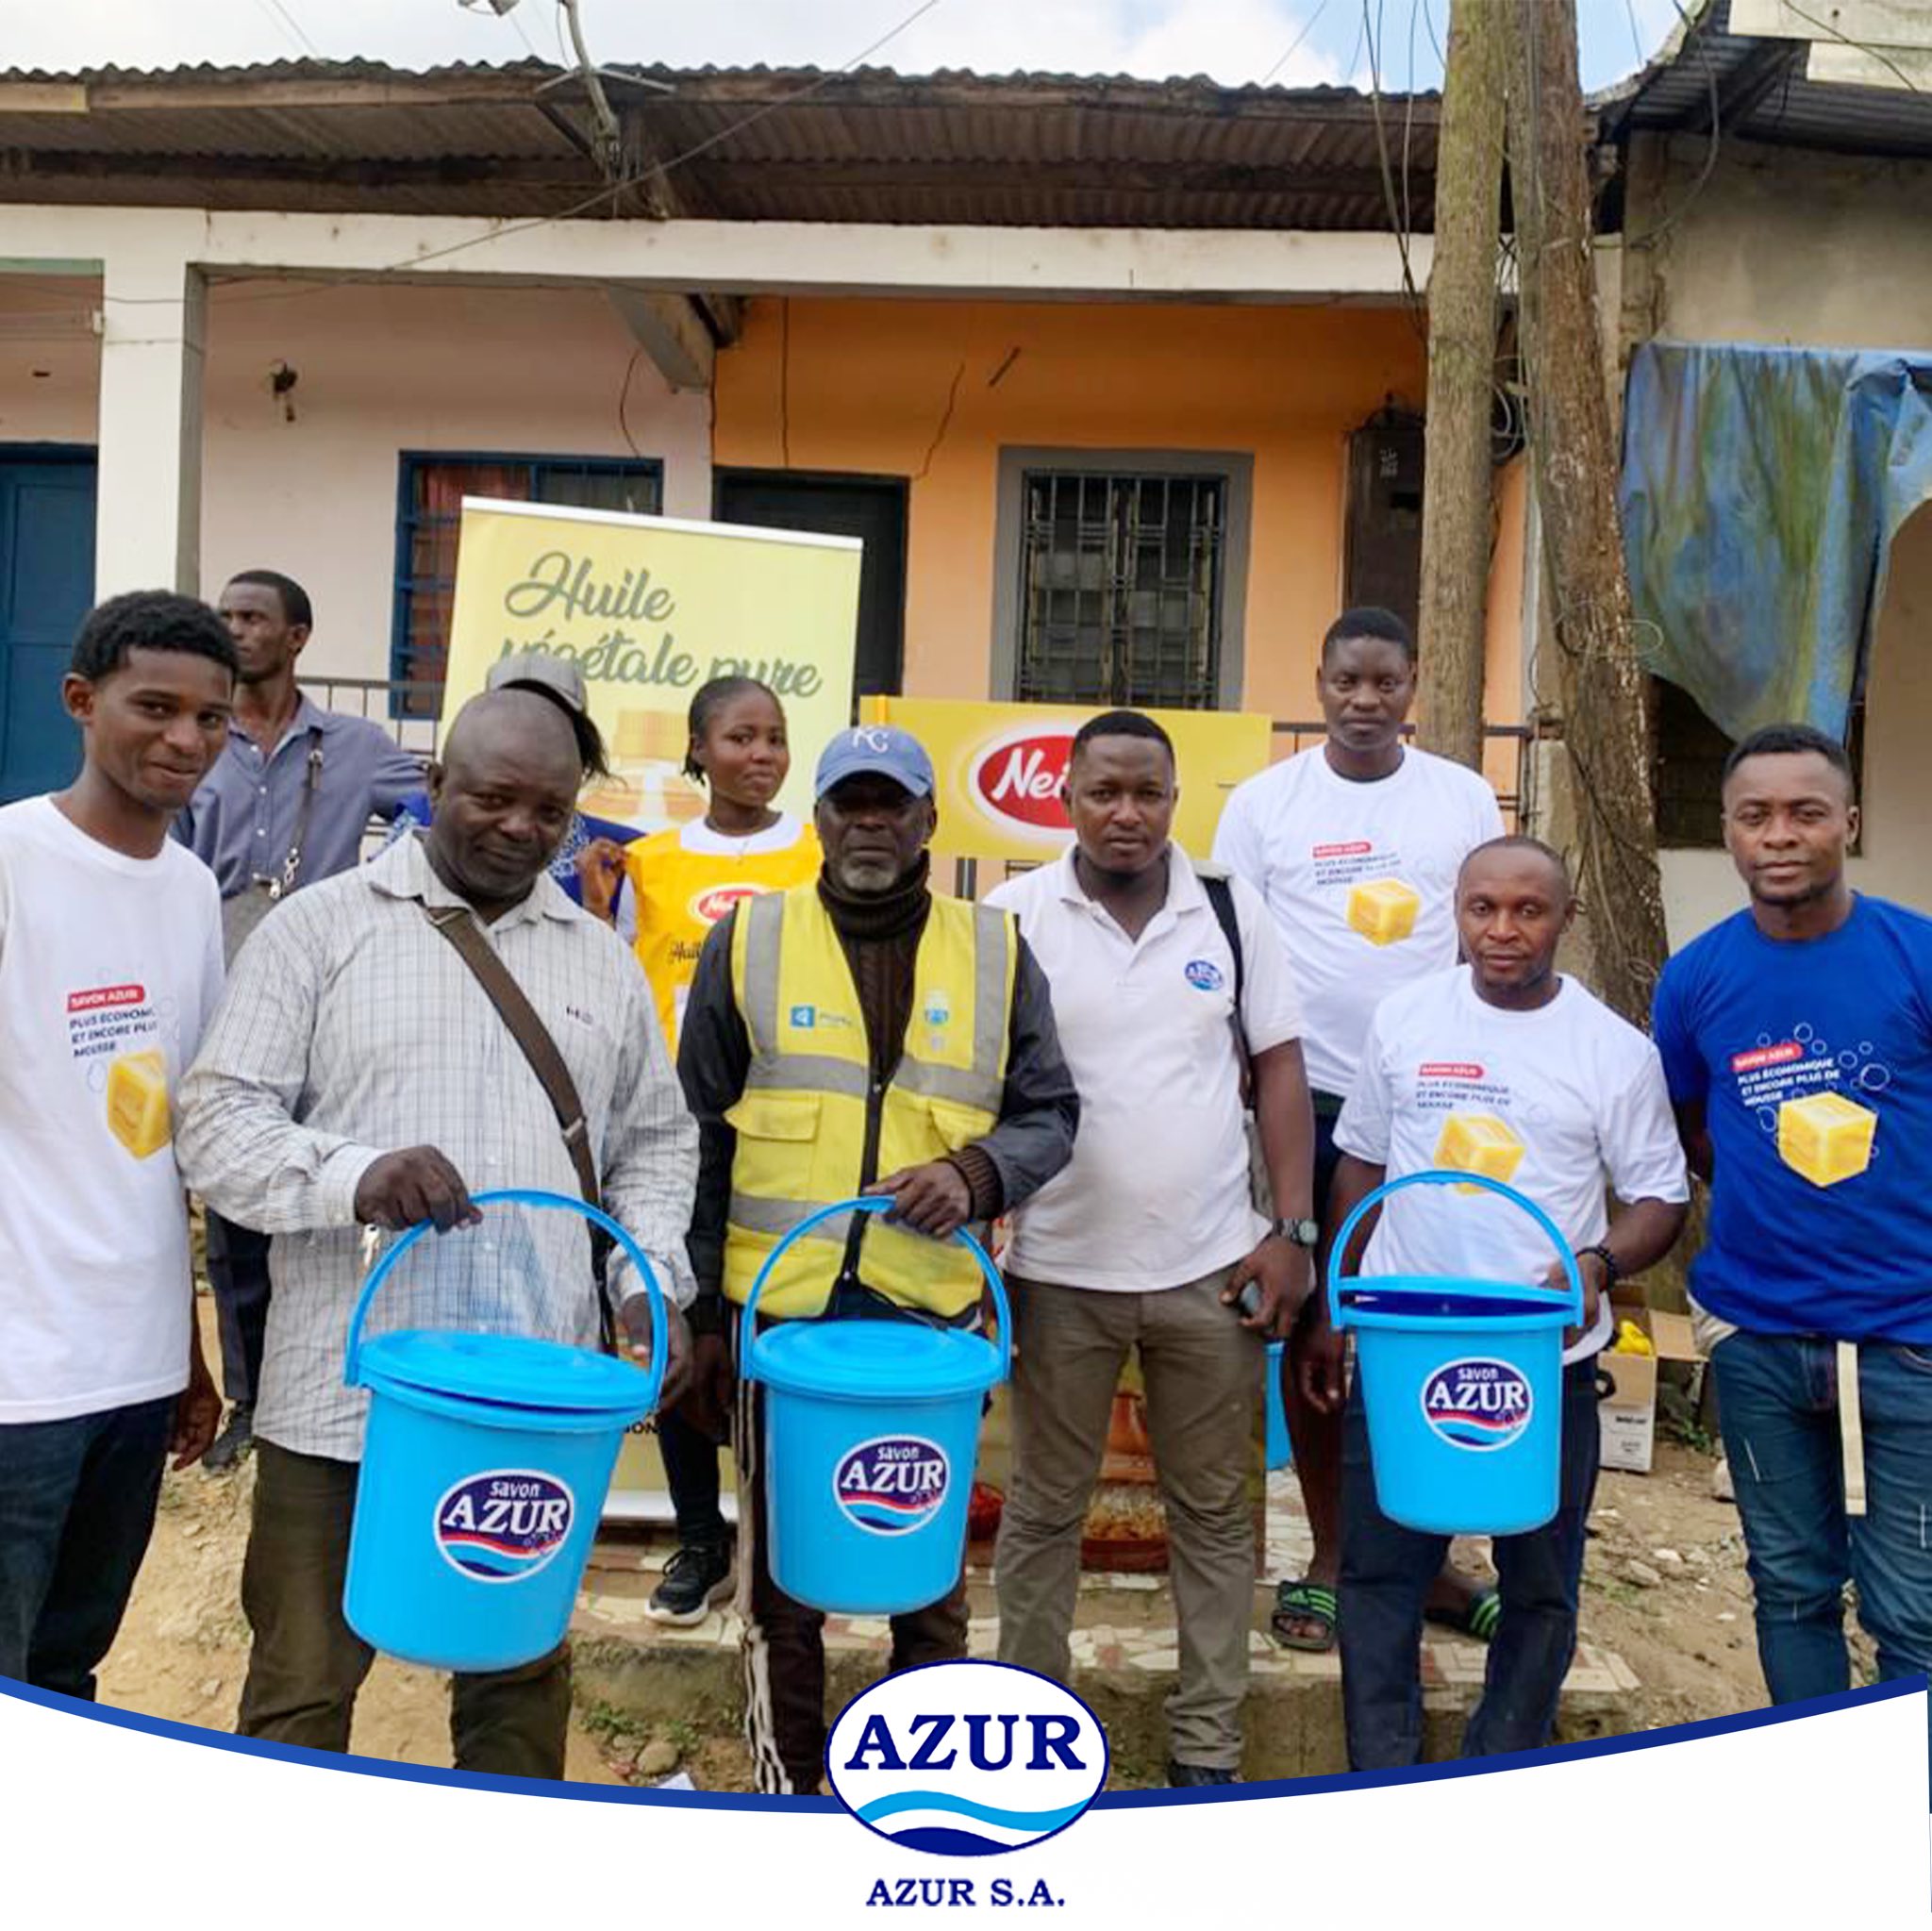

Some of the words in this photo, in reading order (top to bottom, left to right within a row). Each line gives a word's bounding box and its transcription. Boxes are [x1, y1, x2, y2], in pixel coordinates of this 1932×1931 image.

[505, 551, 675, 622] Huile
[499, 628, 699, 687] vétale
[1457, 1367, 1499, 1381] savon
[1427, 1380, 1525, 1412] AZUR
[877, 1446, 920, 1461] savon
[490, 1480, 541, 1498] savon
[841, 1458, 944, 1493] AZUR
[442, 1494, 567, 1536] AZUR
